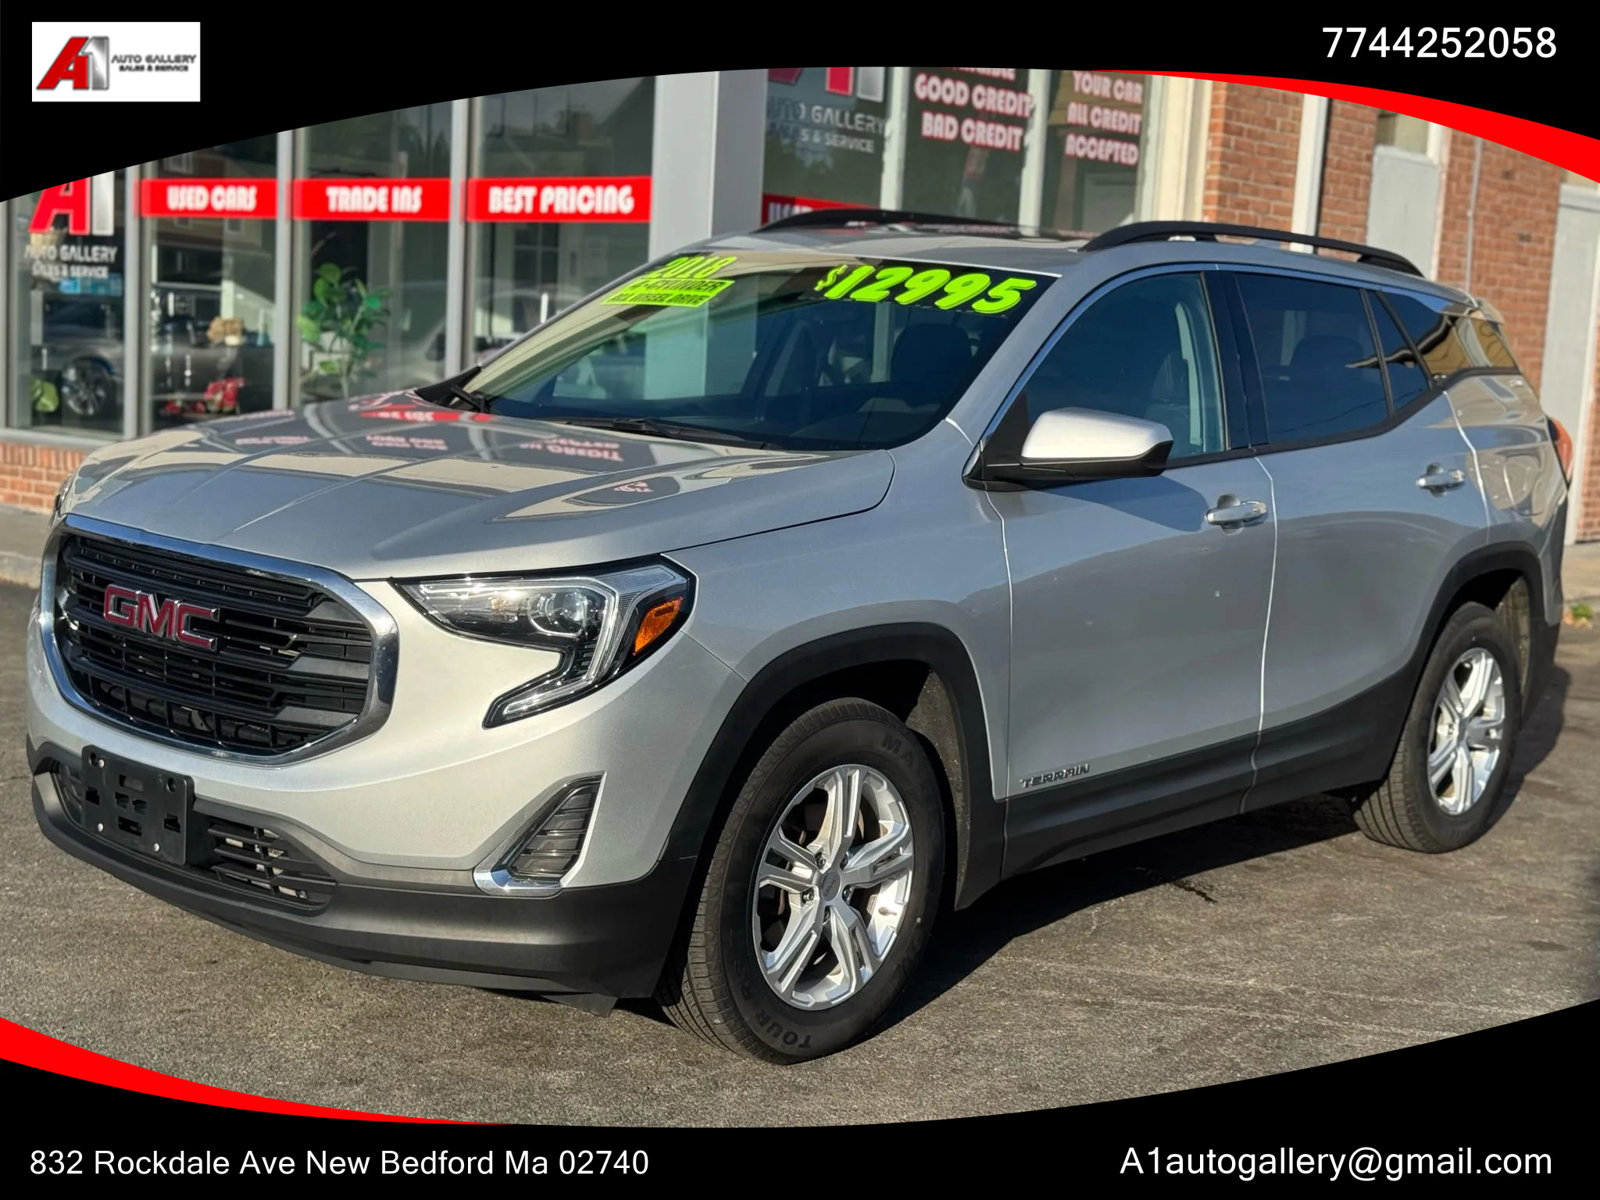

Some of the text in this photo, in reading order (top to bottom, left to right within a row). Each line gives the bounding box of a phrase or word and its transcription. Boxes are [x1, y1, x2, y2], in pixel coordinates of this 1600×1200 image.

[914, 73, 970, 106] GOOD
[971, 83, 1034, 118] CREDIT
[1072, 70, 1143, 105] YOUR CAR
[811, 105, 885, 134] GALLERY
[922, 110, 1024, 151] BAD CREDIT
[1090, 105, 1142, 135] CREDIT
[825, 133, 875, 154] SERVICE
[1065, 133, 1139, 166] ACCEPTED
[166, 185, 258, 212] USED CARS
[325, 186, 423, 214] TRADE INS
[488, 185, 635, 214] BEST PRICING
[60, 245, 118, 263] GALLERY
[642, 256, 738, 279] 2018
[814, 264, 1037, 314] $12995
[103, 584, 220, 650] GMC
[1020, 763, 1091, 788] TERRAIN
